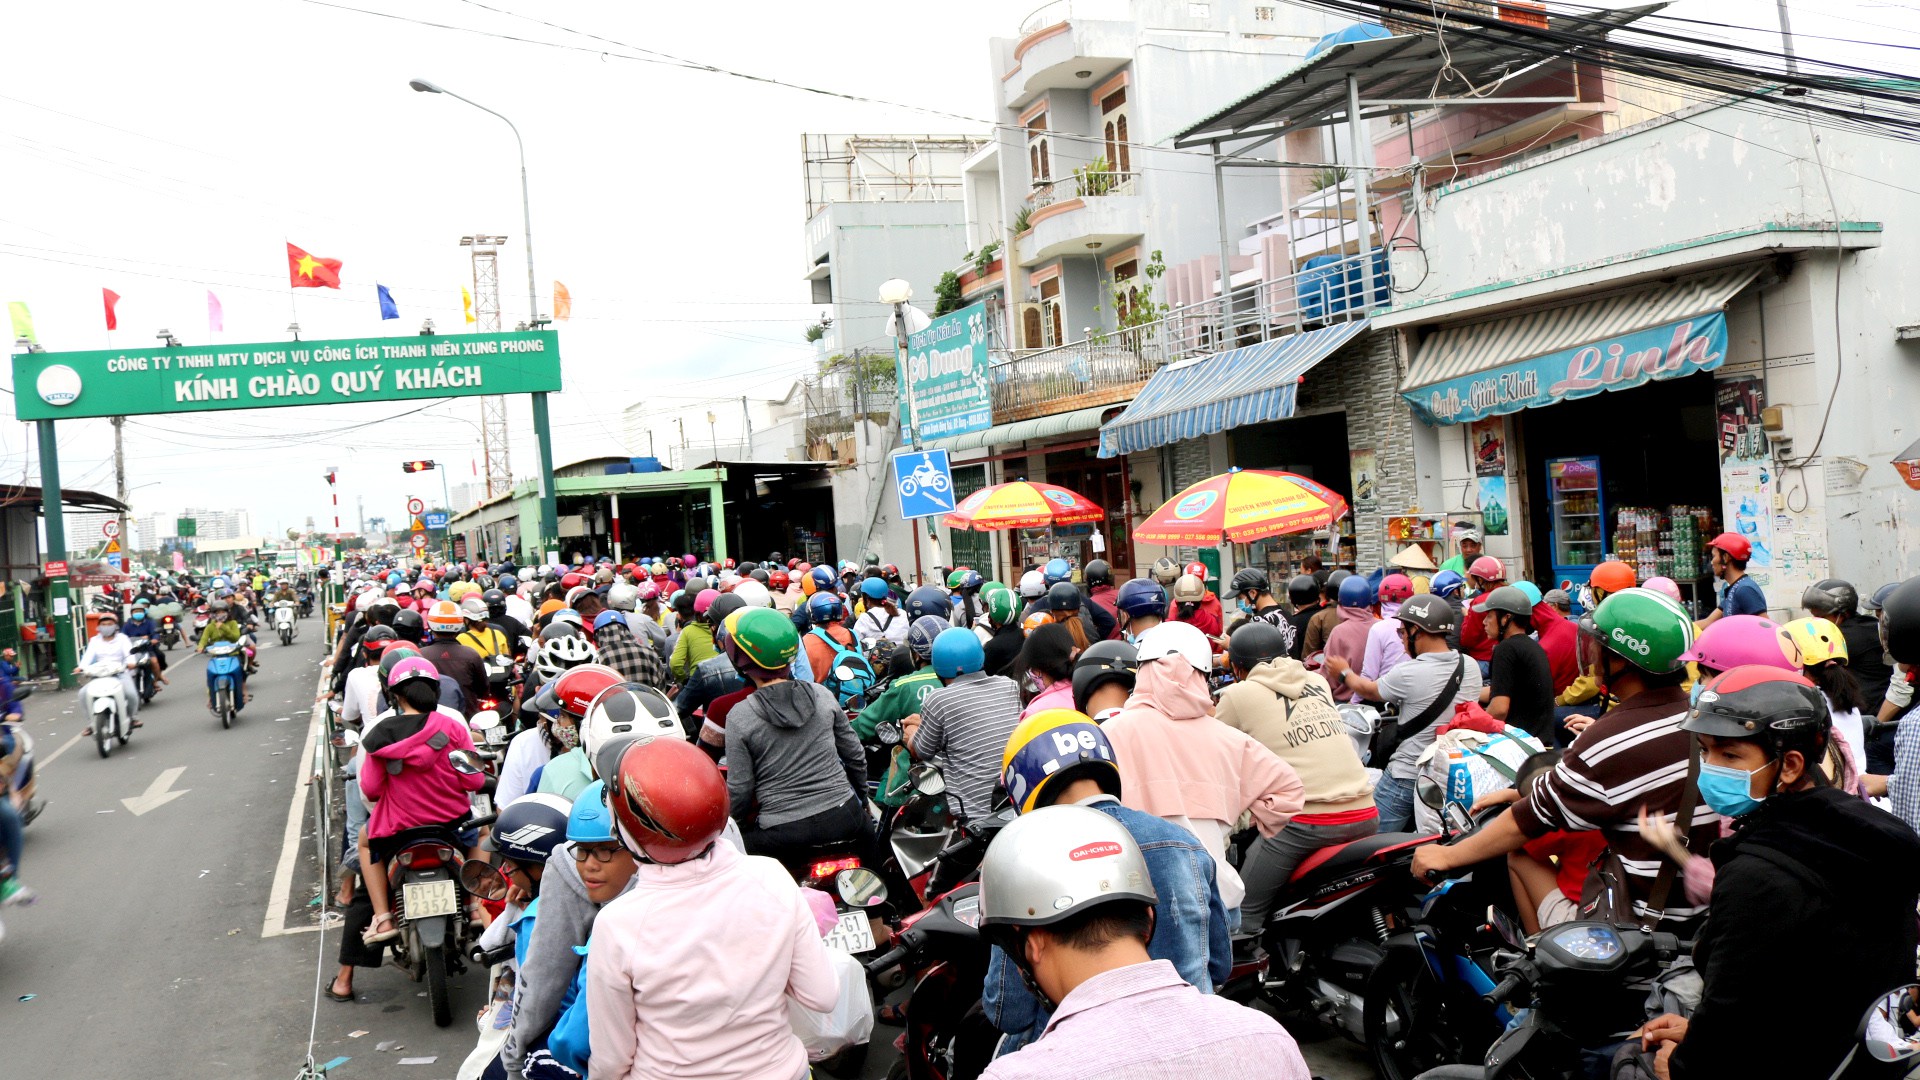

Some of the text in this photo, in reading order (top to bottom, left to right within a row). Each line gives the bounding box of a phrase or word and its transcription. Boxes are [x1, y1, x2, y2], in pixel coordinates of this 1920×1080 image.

[912, 334, 927, 351] Dịch
[937, 321, 951, 340] Nấu
[107, 339, 544, 373] CÔNG TY TNHH MTV DỊCH VỤ CÔNG ÍCH THANH NIÊN XUNG PHONG
[930, 344, 973, 379] Dung
[1548, 321, 1720, 396] Linh
[174, 361, 482, 402] KÍNH CHÀO QUÝ KHÁCH
[1469, 378, 1498, 416] Giải
[1500, 369, 1539, 404] Khát
[1568, 463, 1592, 475] pepsi
[1228, 504, 1255, 514] CHUYÊN
[1273, 495, 1296, 504] DOANH
[1269, 522, 1284, 531] 9999
[1611, 627, 1650, 656] Grab
[1052, 730, 1096, 757] be
[1454, 768, 1466, 800] C225
[1073, 844, 1119, 858] DAI-ICHI LIFE
[411, 883, 446, 900] 61-L7
[412, 897, 450, 916] 2352
